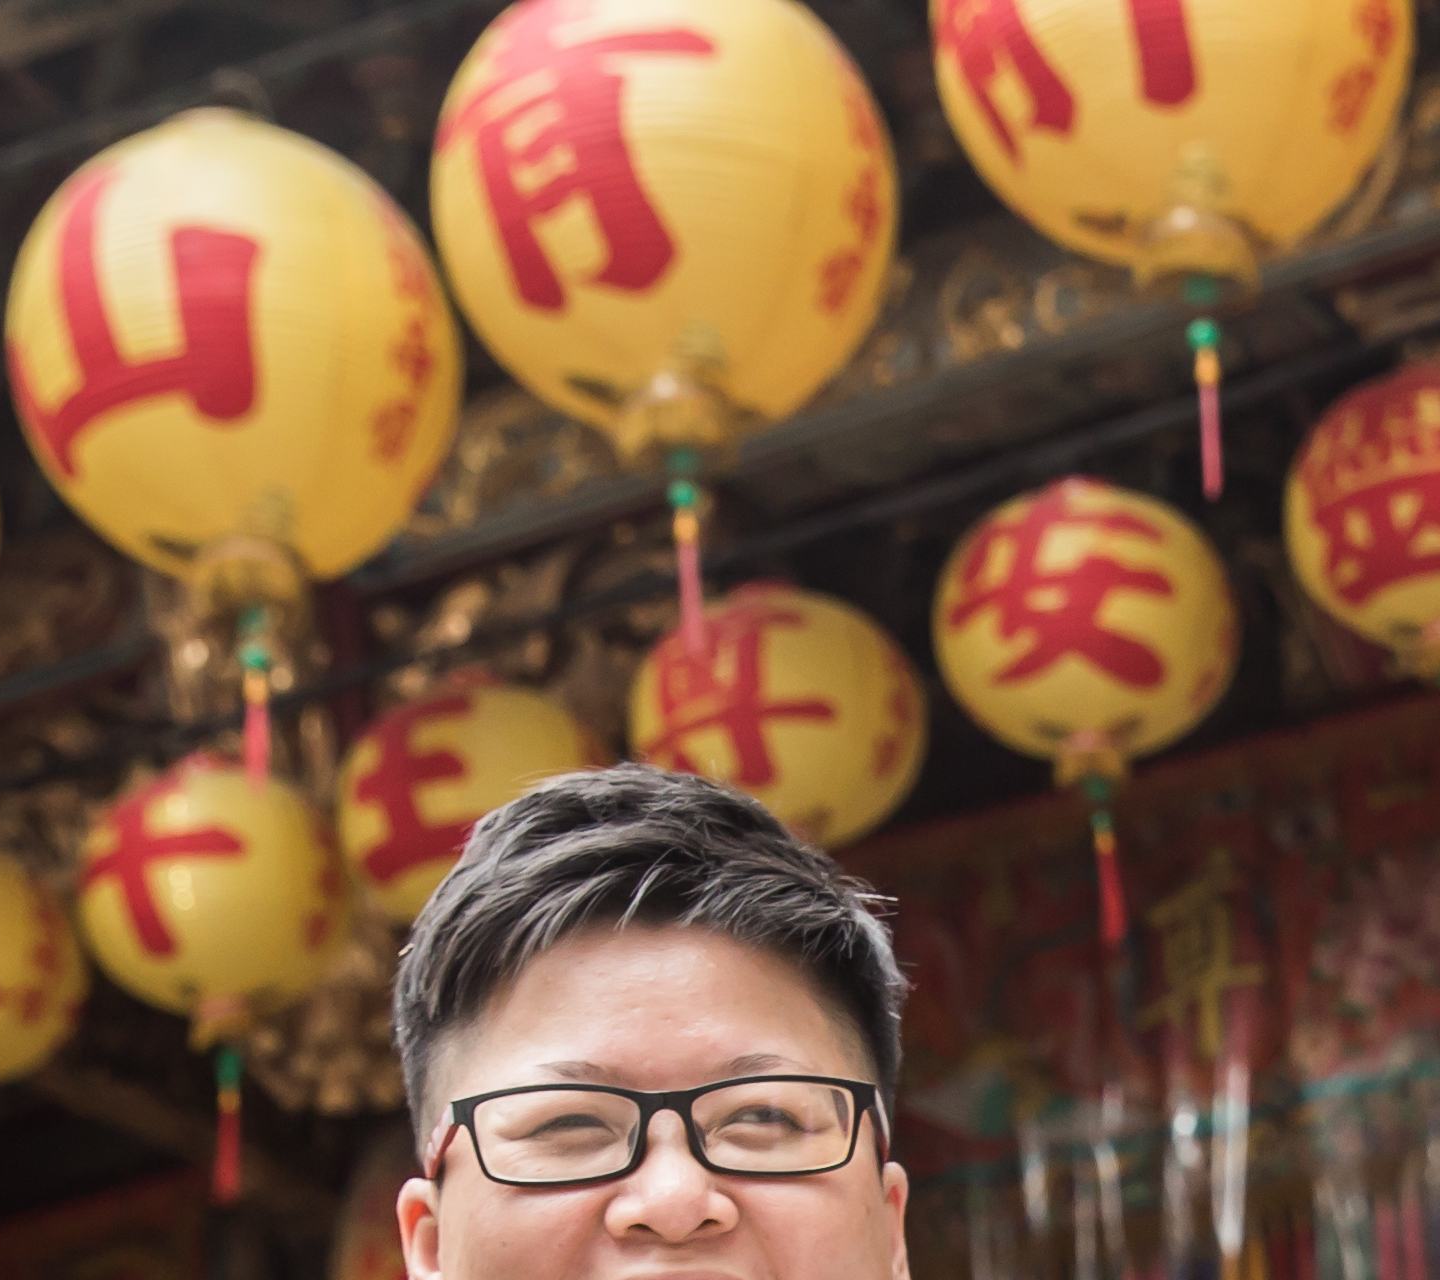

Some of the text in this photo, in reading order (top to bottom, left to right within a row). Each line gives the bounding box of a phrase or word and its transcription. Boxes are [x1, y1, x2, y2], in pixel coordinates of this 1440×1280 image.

[6, 163, 258, 477] 山
[948, 485, 1174, 693] 安
[82, 763, 243, 957] 千
